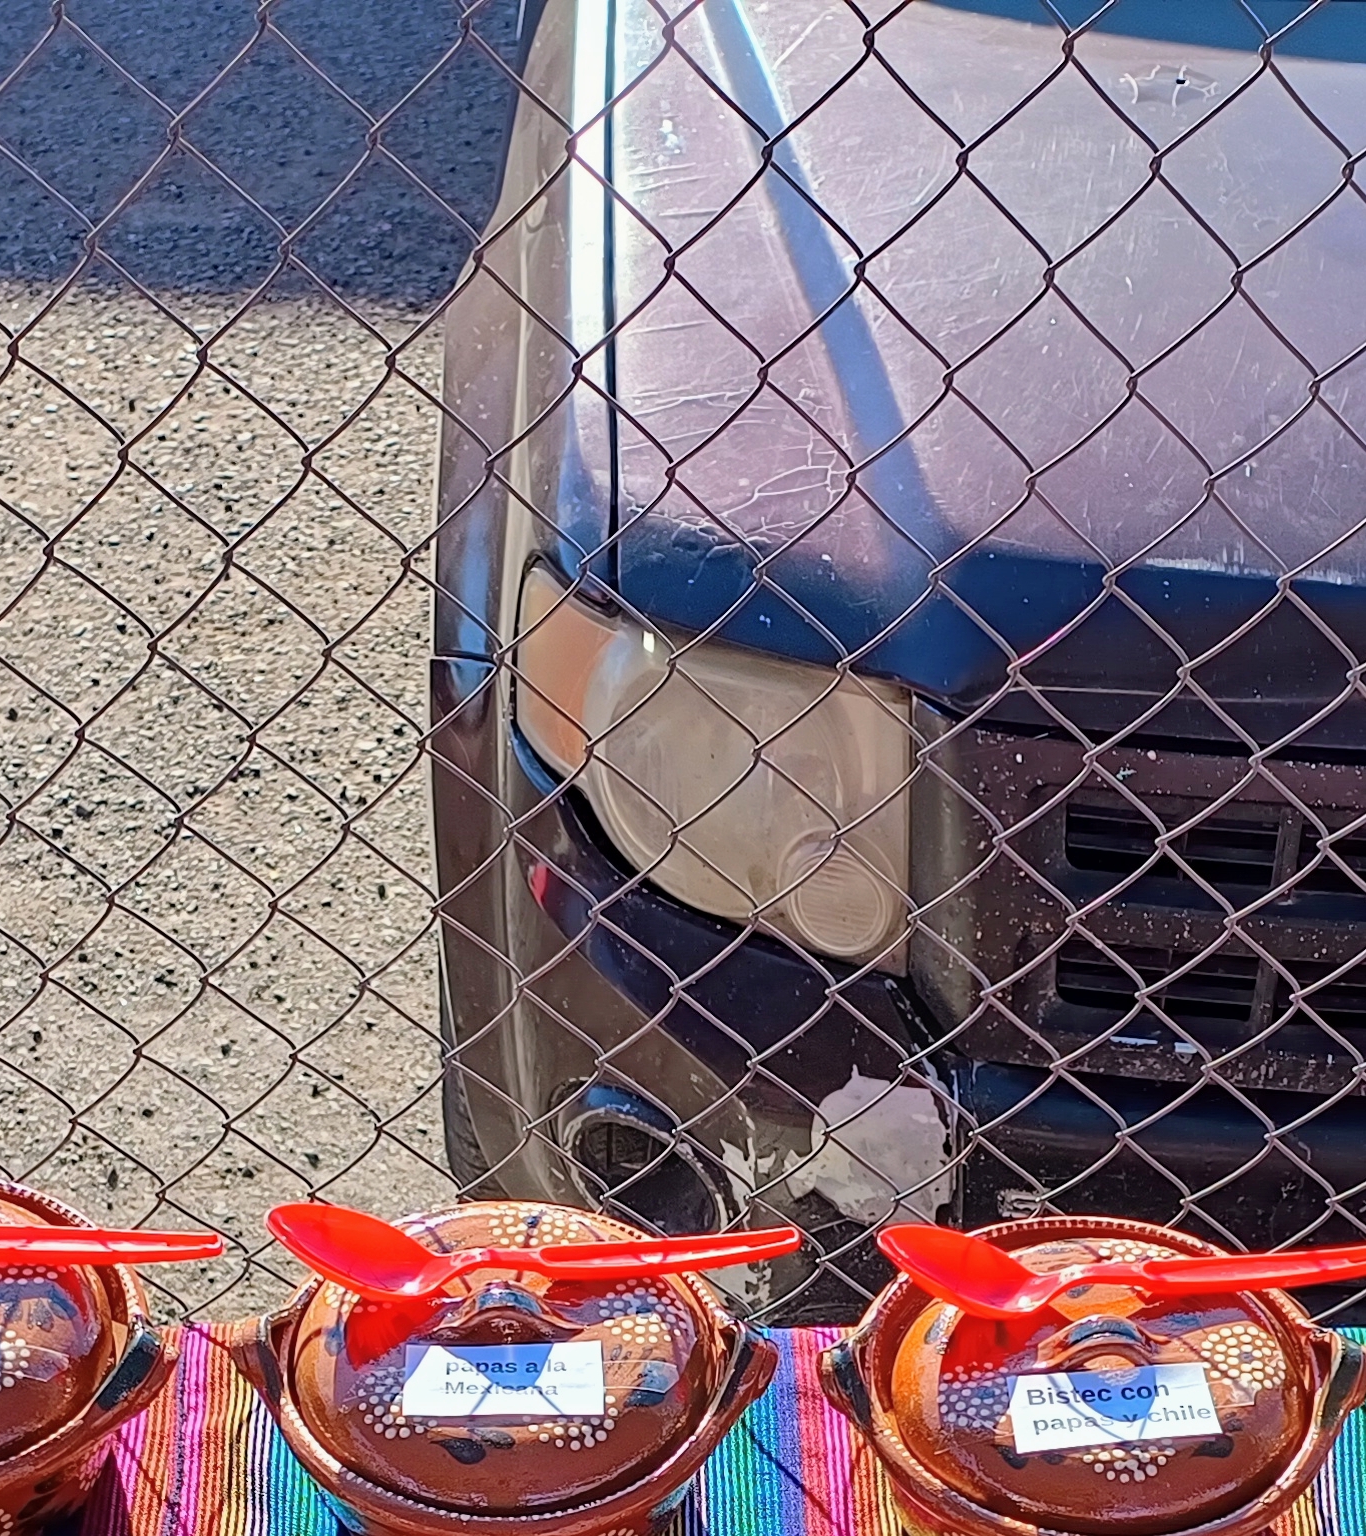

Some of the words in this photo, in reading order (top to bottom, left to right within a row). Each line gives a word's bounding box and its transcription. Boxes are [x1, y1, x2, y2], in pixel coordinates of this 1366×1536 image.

[445, 1359, 518, 1375] papas
[525, 1361, 539, 1373] a
[546, 1358, 567, 1372] la
[445, 1381, 558, 1396] Mexicana
[1026, 1387, 1112, 1406] Bistec
[1120, 1384, 1170, 1401] con
[1033, 1413, 1114, 1436] papas
[1123, 1412, 1138, 1429] y
[1147, 1404, 1212, 1423] chile
